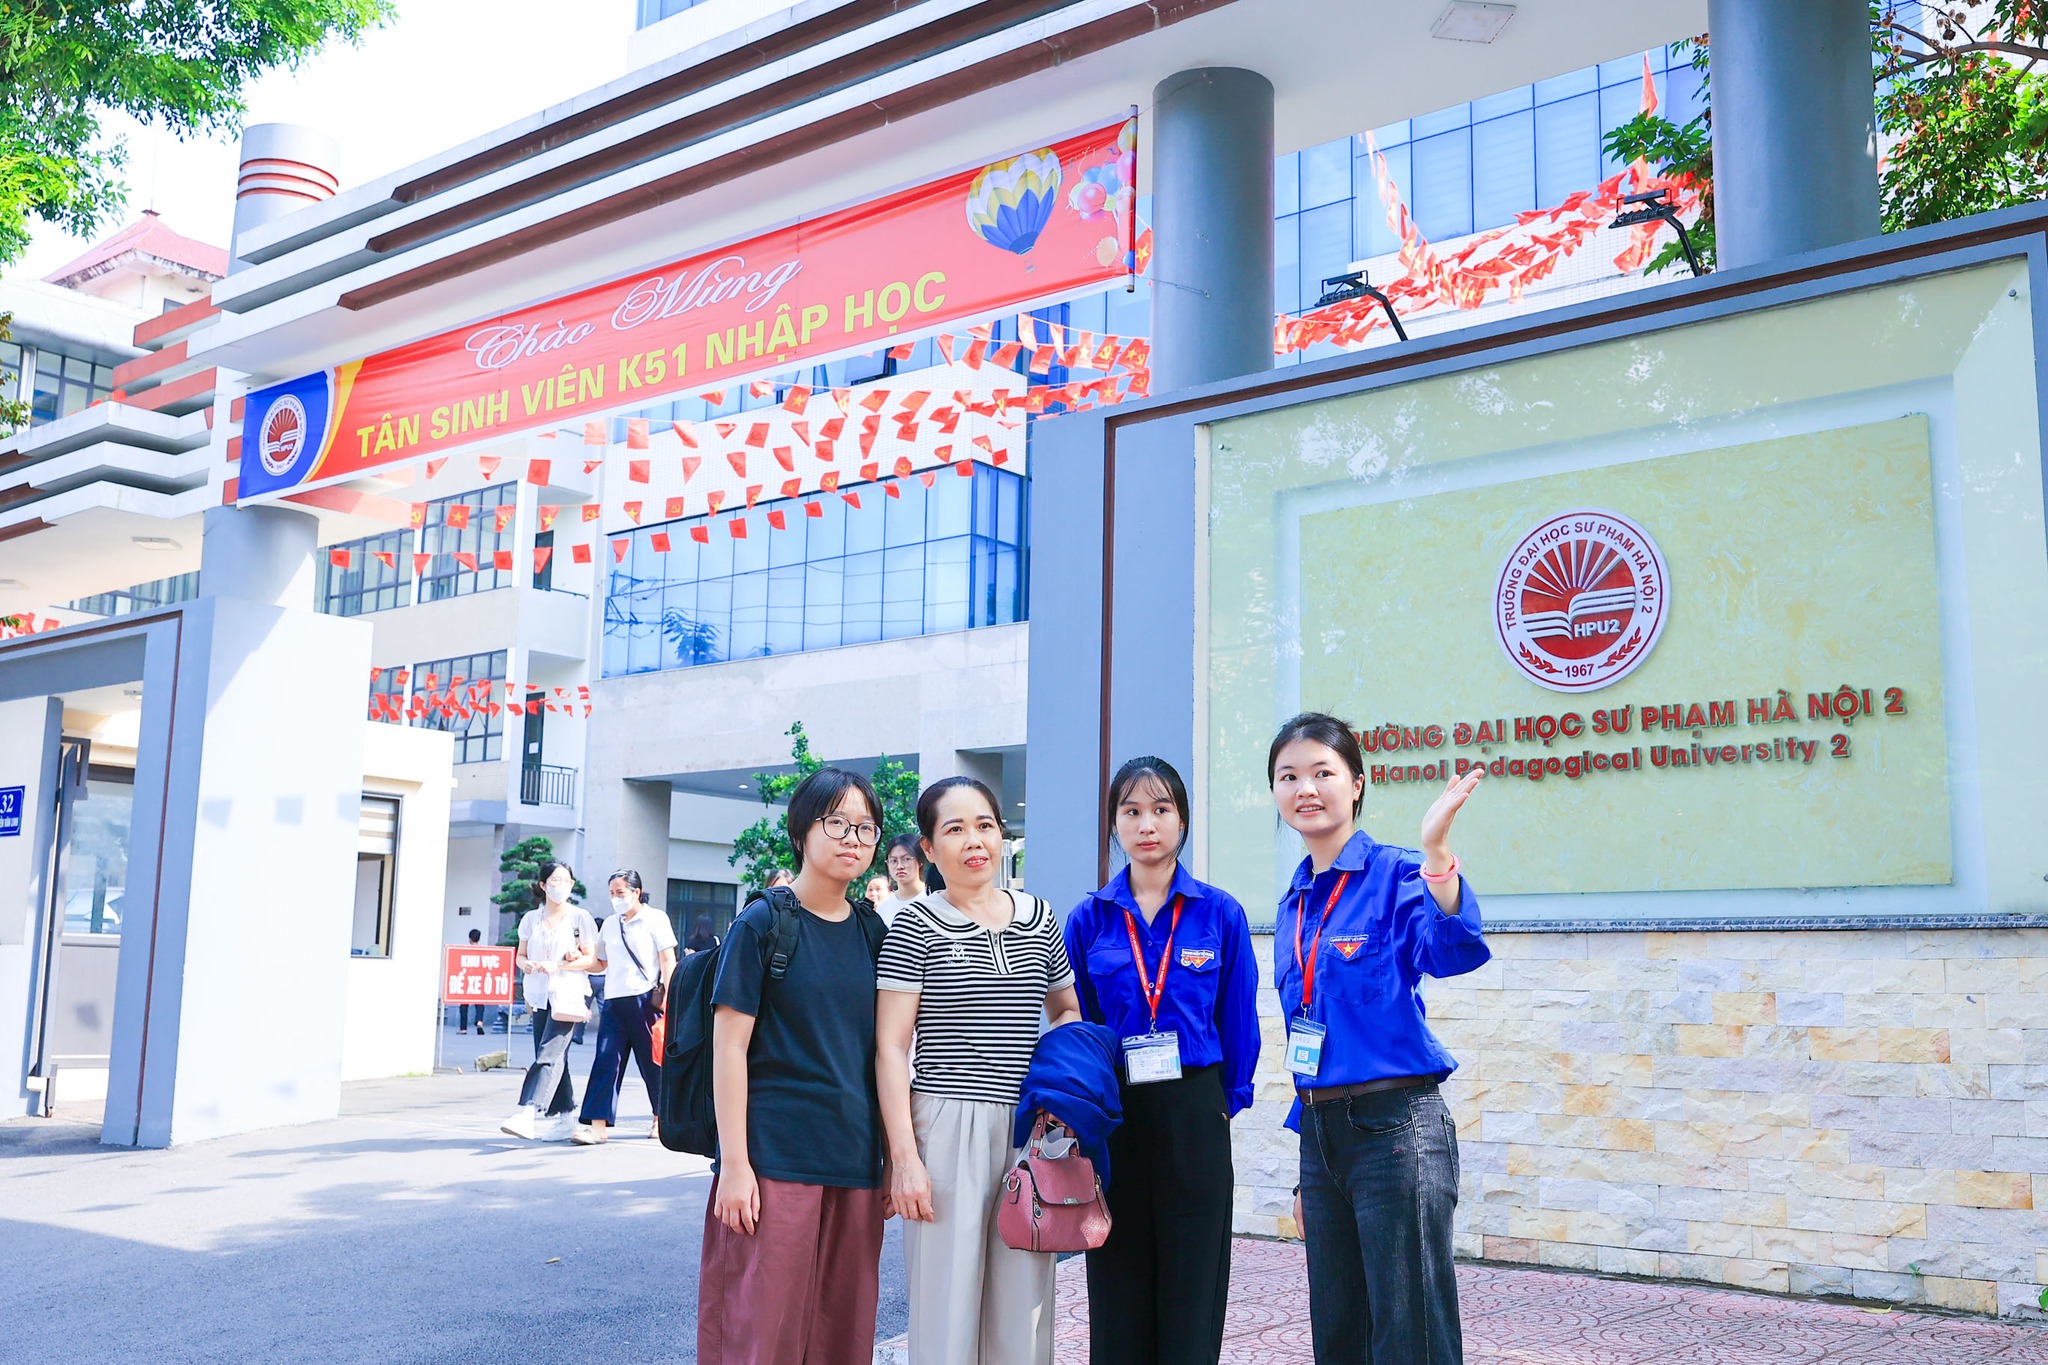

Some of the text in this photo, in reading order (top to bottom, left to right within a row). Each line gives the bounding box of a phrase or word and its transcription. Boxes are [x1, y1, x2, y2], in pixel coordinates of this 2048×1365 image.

[465, 255, 803, 369] Chào Mừng
[356, 413, 420, 458] TÂN
[430, 389, 510, 440] SINH
[521, 363, 605, 416] VIÊN
[618, 341, 687, 392] K51
[706, 303, 829, 369] NHẬP
[844, 271, 946, 334] HỌC
[1502, 521, 1657, 630] TRƯỜNG ĐẠI HỌC SƯ PHẠM HÀ NỘI 2
[1574, 618, 1621, 638] HPU2
[1564, 663, 1594, 678] 1967
[1352, 684, 1906, 754] ƯỜNG ĐẠI HỌC SƯ PHẠM HÀ NỘI 2
[1371, 759, 1449, 784] Hanoi
[1650, 736, 1820, 767] University
[1830, 733, 1851, 759] 2
[460, 954, 480, 968] KHU
[466, 975, 482, 995] XE
[483, 972, 492, 995] Ô
[494, 972, 509, 995] TÔ
